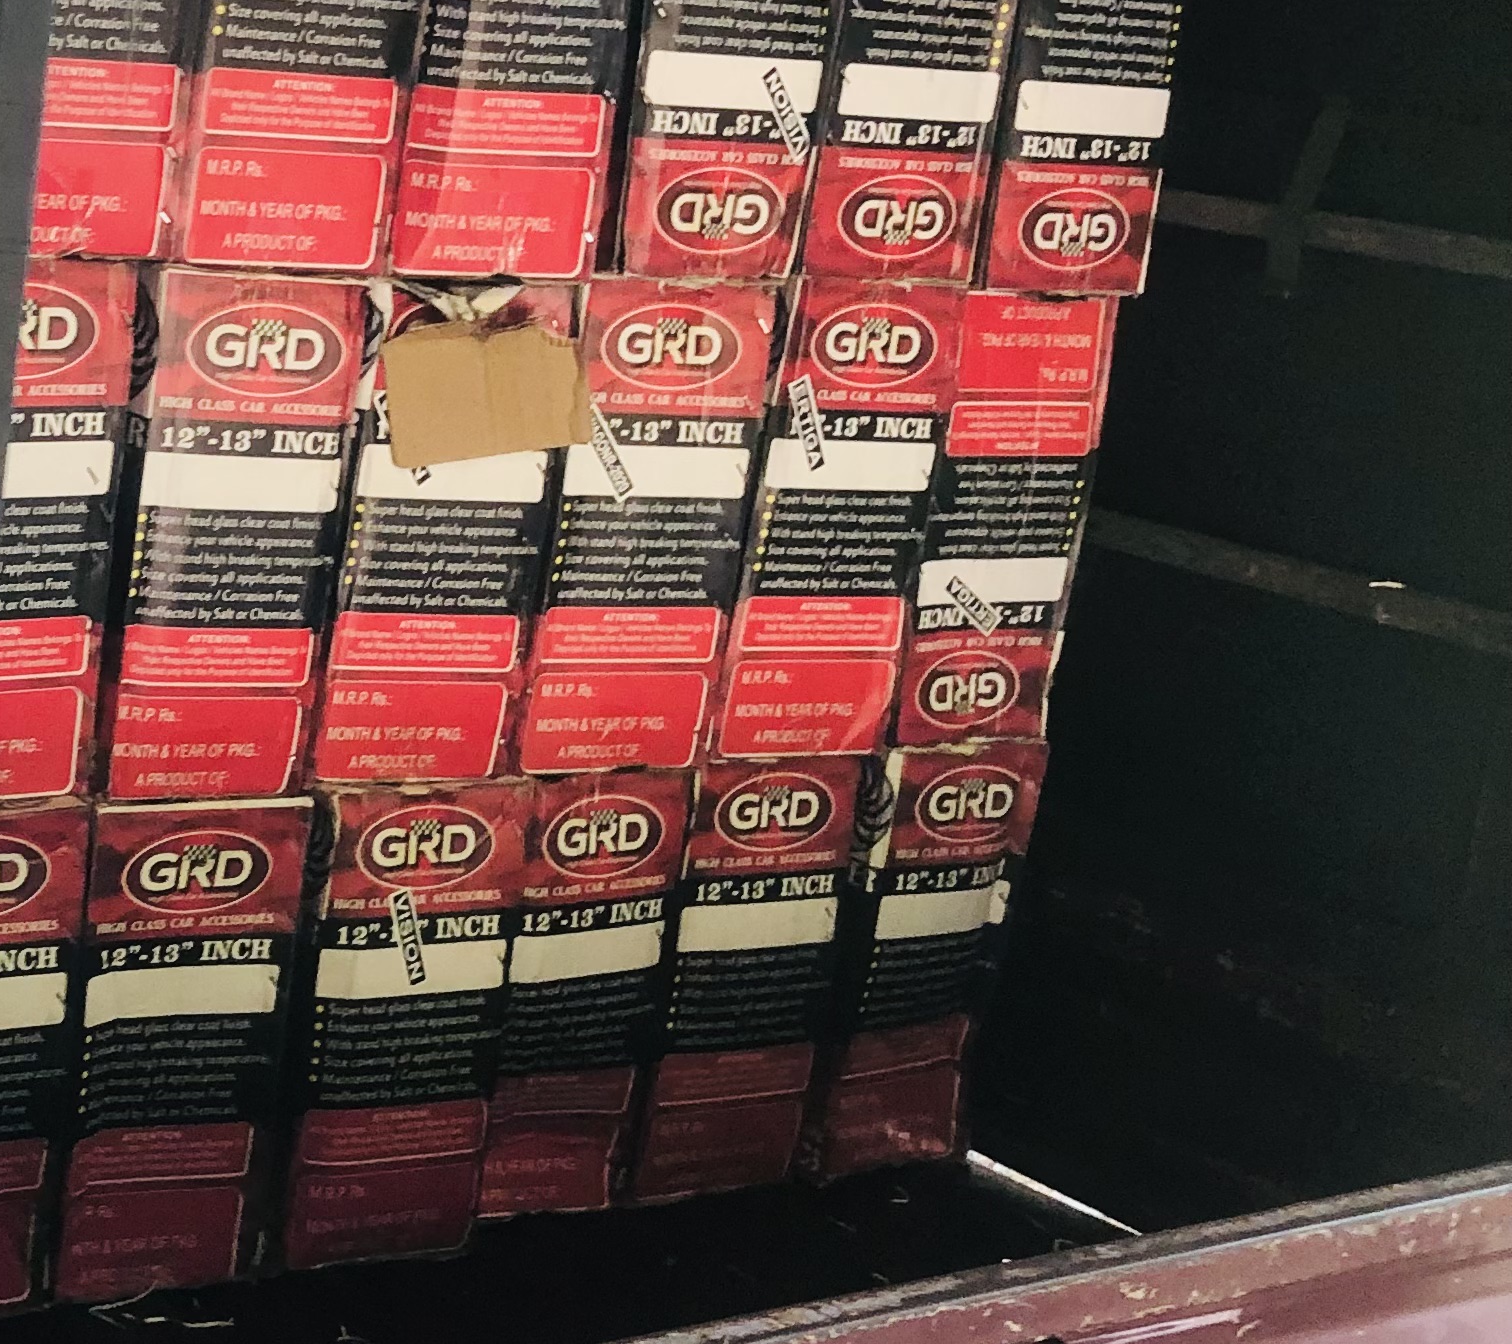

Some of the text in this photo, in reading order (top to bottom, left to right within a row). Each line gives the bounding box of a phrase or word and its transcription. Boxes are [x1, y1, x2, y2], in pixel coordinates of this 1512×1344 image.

[651, 110, 719, 135] INCH
[766, 72, 808, 158] VISION
[840, 120, 902, 145] INCH
[1020, 135, 1077, 158] INCH
[259, 203, 292, 219] YEAR
[669, 192, 770, 240] GRD
[854, 198, 945, 246] GRD
[1033, 212, 1118, 256] GRD
[205, 319, 326, 371] GRD
[617, 317, 723, 365] GRD
[825, 317, 922, 364] GRD
[30, 412, 106, 438] INCH
[678, 420, 745, 444] INCH
[873, 417, 933, 439] INCH
[929, 671, 1007, 715] GRD
[729, 785, 819, 830] GRD
[928, 778, 1014, 821] GRD
[371, 819, 476, 867] GRD
[557, 808, 649, 857] GRD
[139, 844, 254, 891] GRD
[781, 873, 835, 898] INCH
[436, 915, 500, 940] INCH
[610, 897, 663, 924] INCH
[202, 938, 273, 962] INCH
[394, 891, 424, 982] VISION
